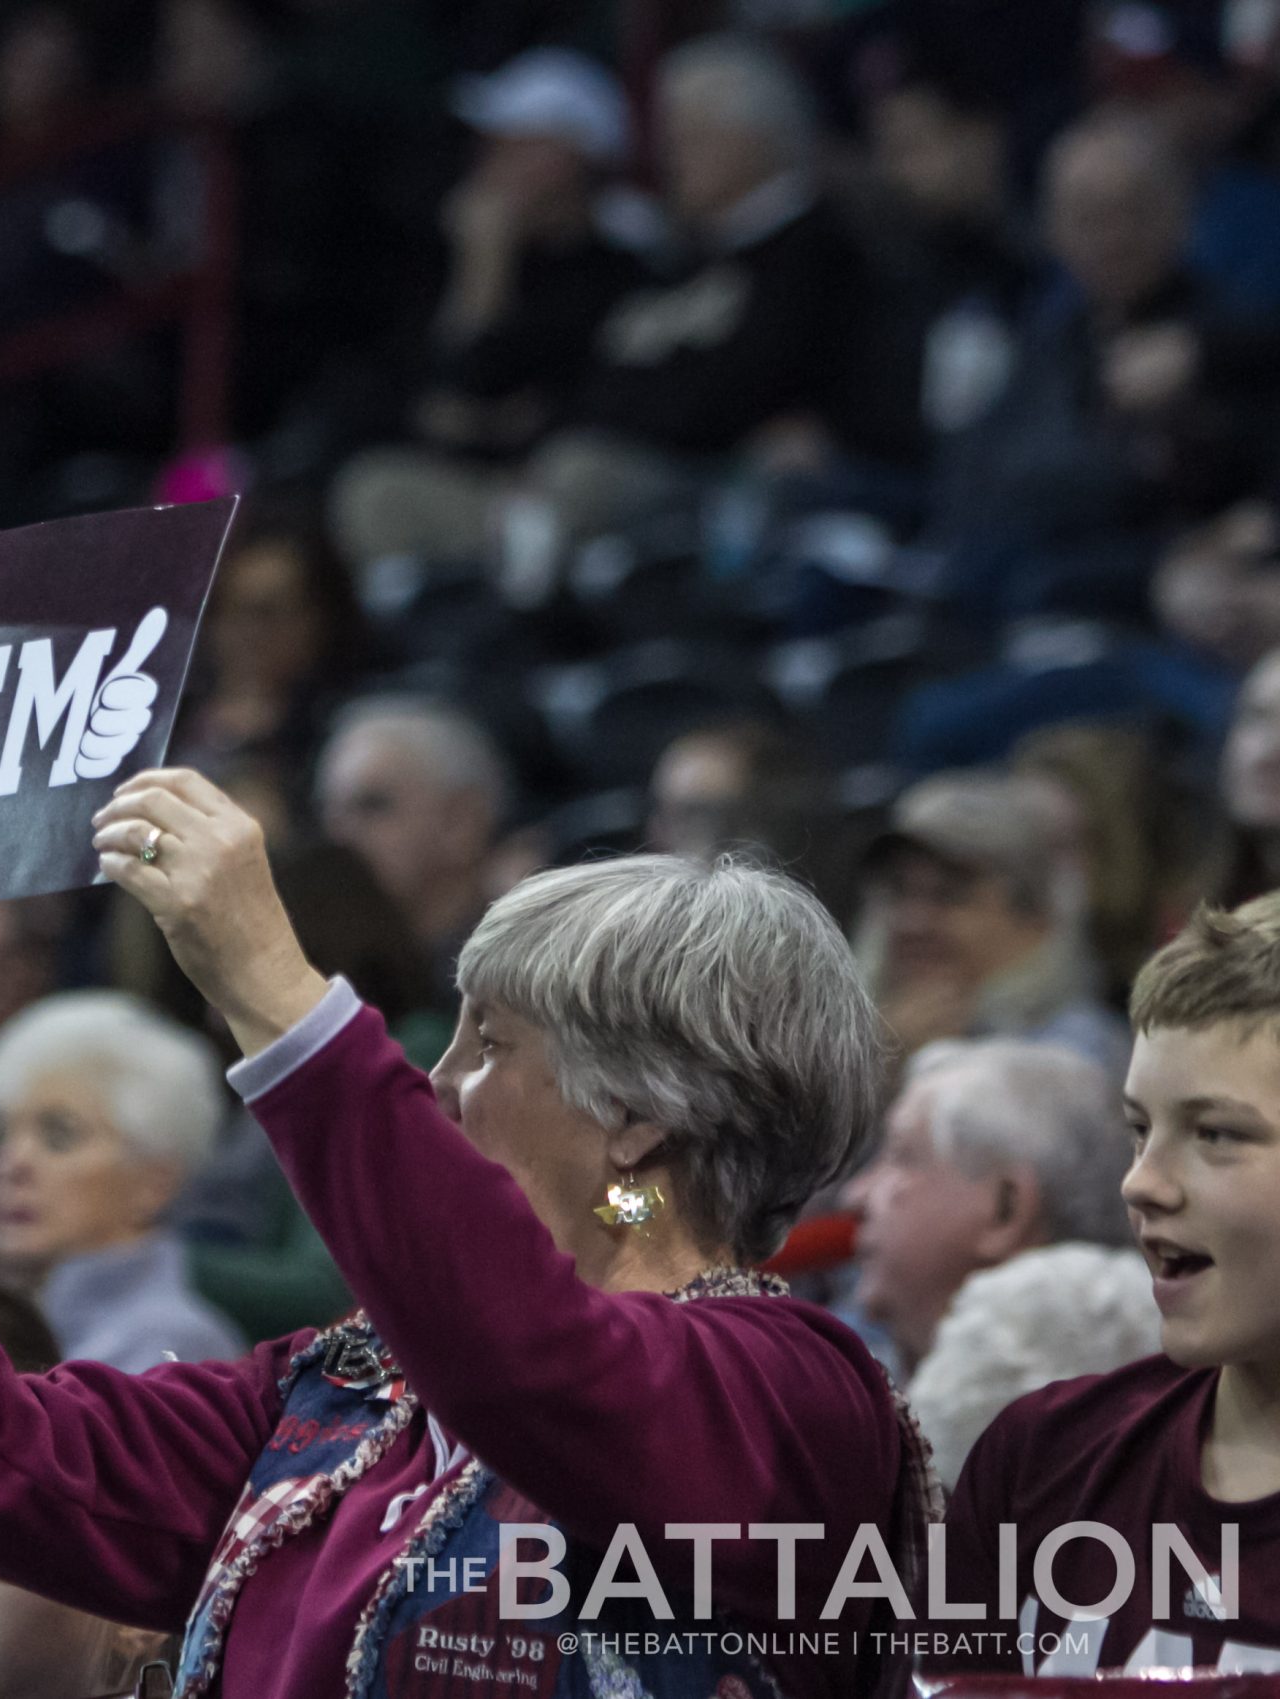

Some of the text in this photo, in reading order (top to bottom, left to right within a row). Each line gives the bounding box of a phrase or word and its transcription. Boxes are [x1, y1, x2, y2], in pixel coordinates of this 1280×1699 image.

[416, 1625, 545, 1662] Rusty '98
[414, 1654, 449, 1675] Civil
